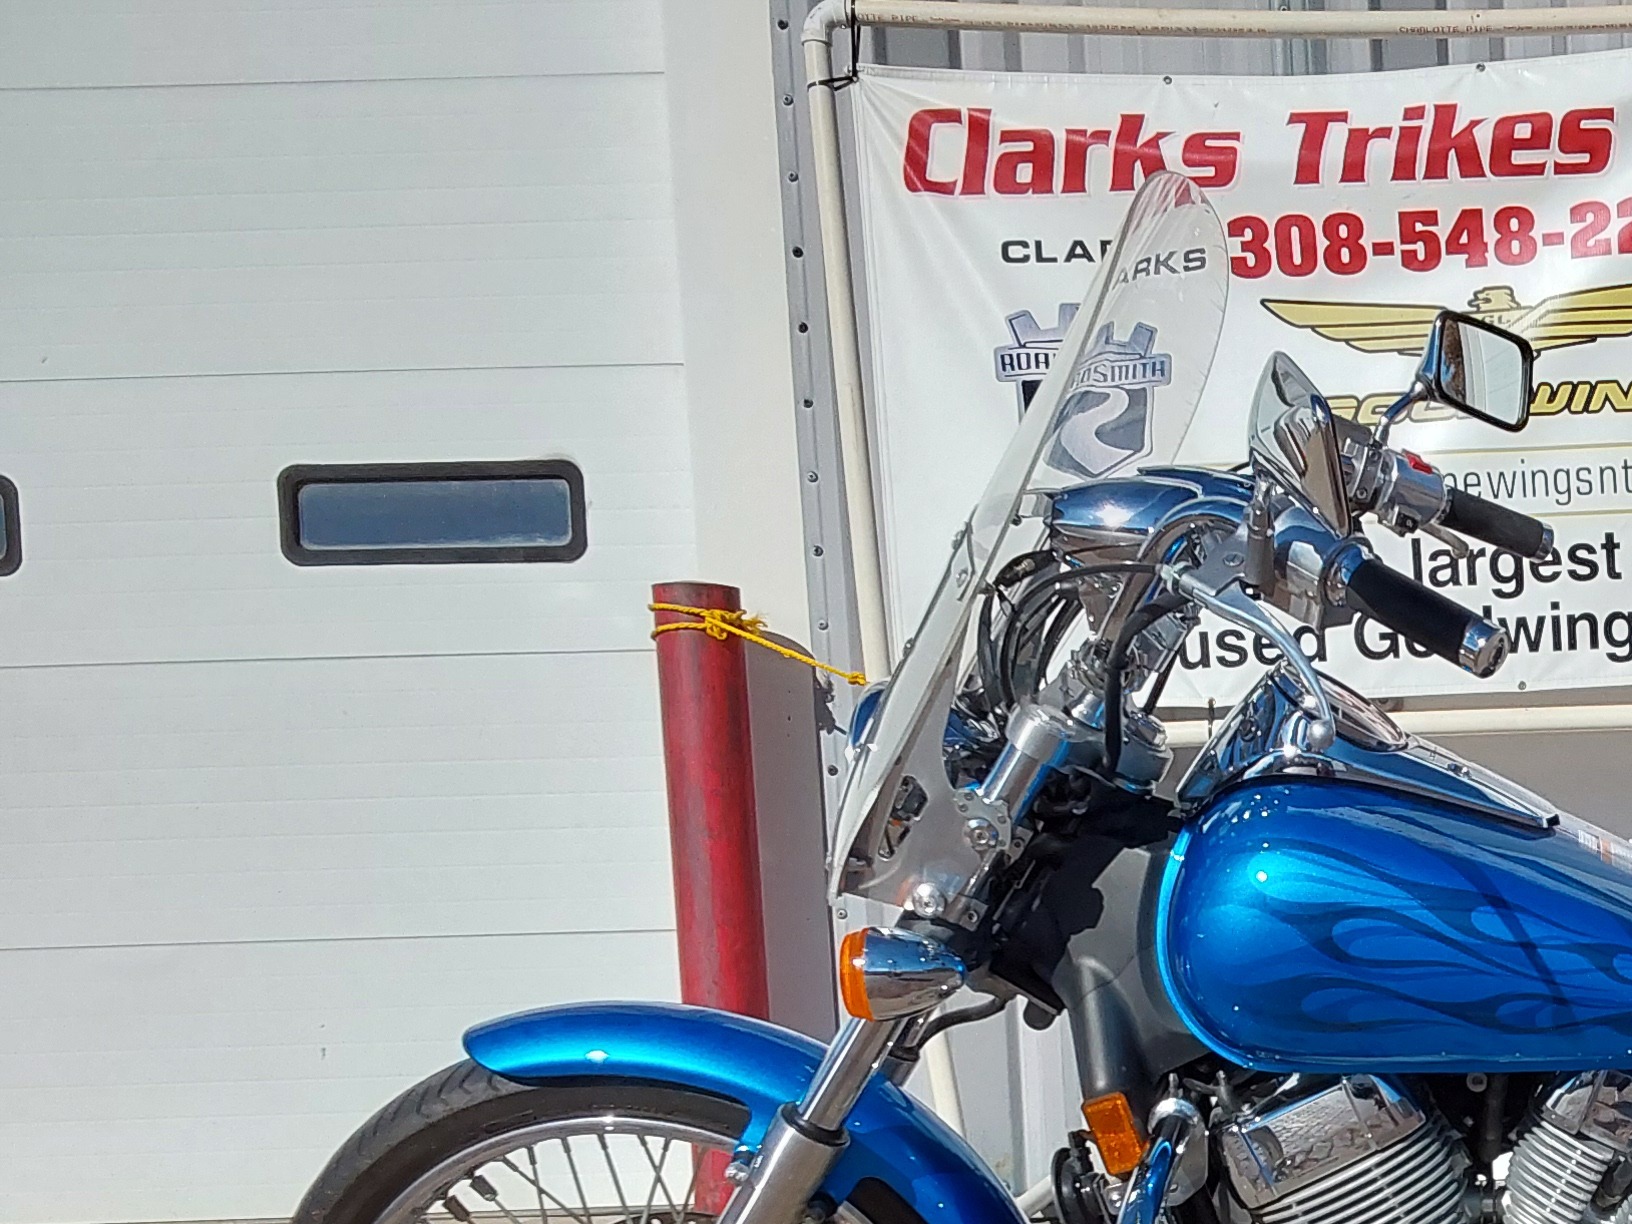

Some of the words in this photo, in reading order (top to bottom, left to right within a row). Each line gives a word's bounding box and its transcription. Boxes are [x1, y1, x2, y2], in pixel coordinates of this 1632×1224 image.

[904, 107, 1242, 197] Clarks
[1287, 103, 1616, 186] Trikes
[1411, 532, 1623, 599] largest
[1179, 622, 1329, 670] used
